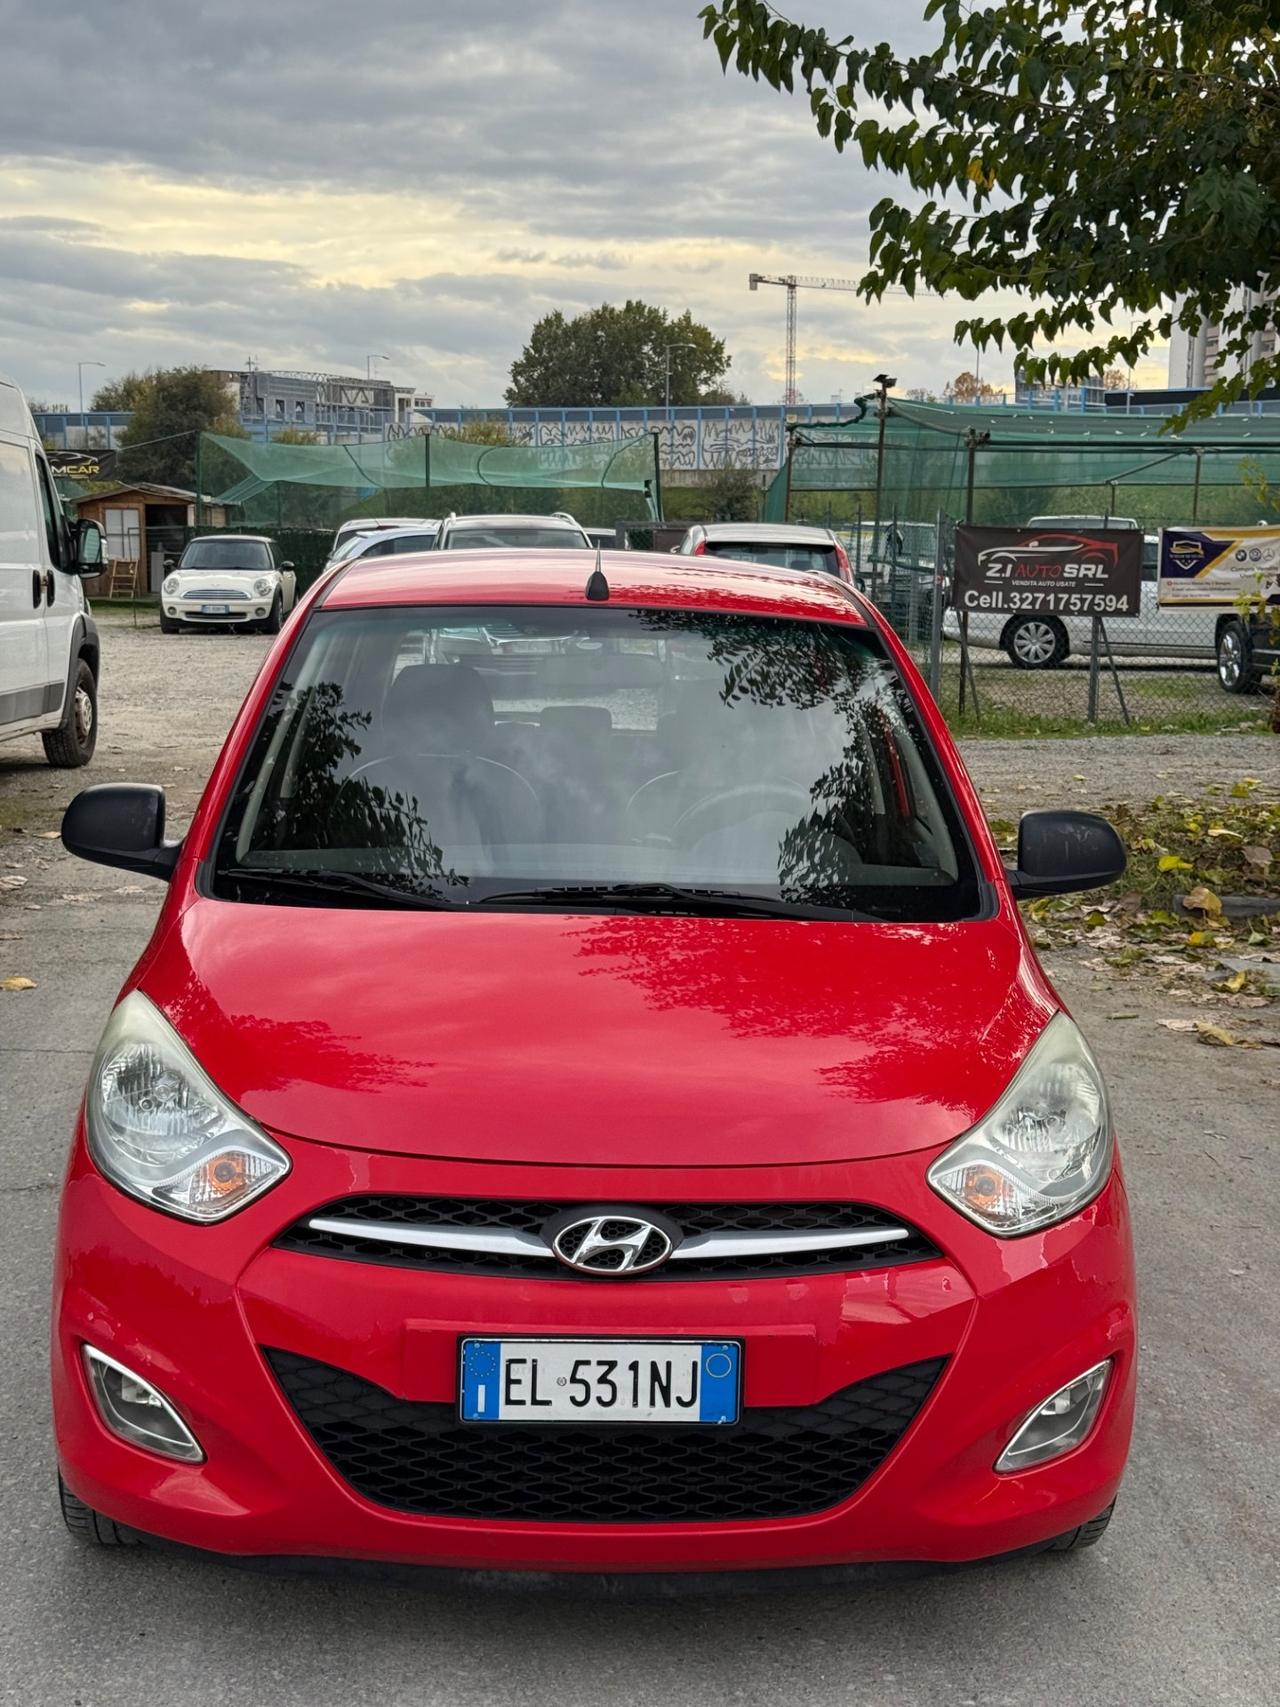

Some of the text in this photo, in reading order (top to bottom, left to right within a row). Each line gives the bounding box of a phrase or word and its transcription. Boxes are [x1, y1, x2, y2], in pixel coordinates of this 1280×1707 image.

[1015, 564, 1062, 578] AUTO
[1063, 564, 1109, 579] SRL
[964, 590, 1129, 612] Cell.3271757594
[504, 1358, 553, 1406] EL
[569, 1359, 699, 1408] 531NJ
